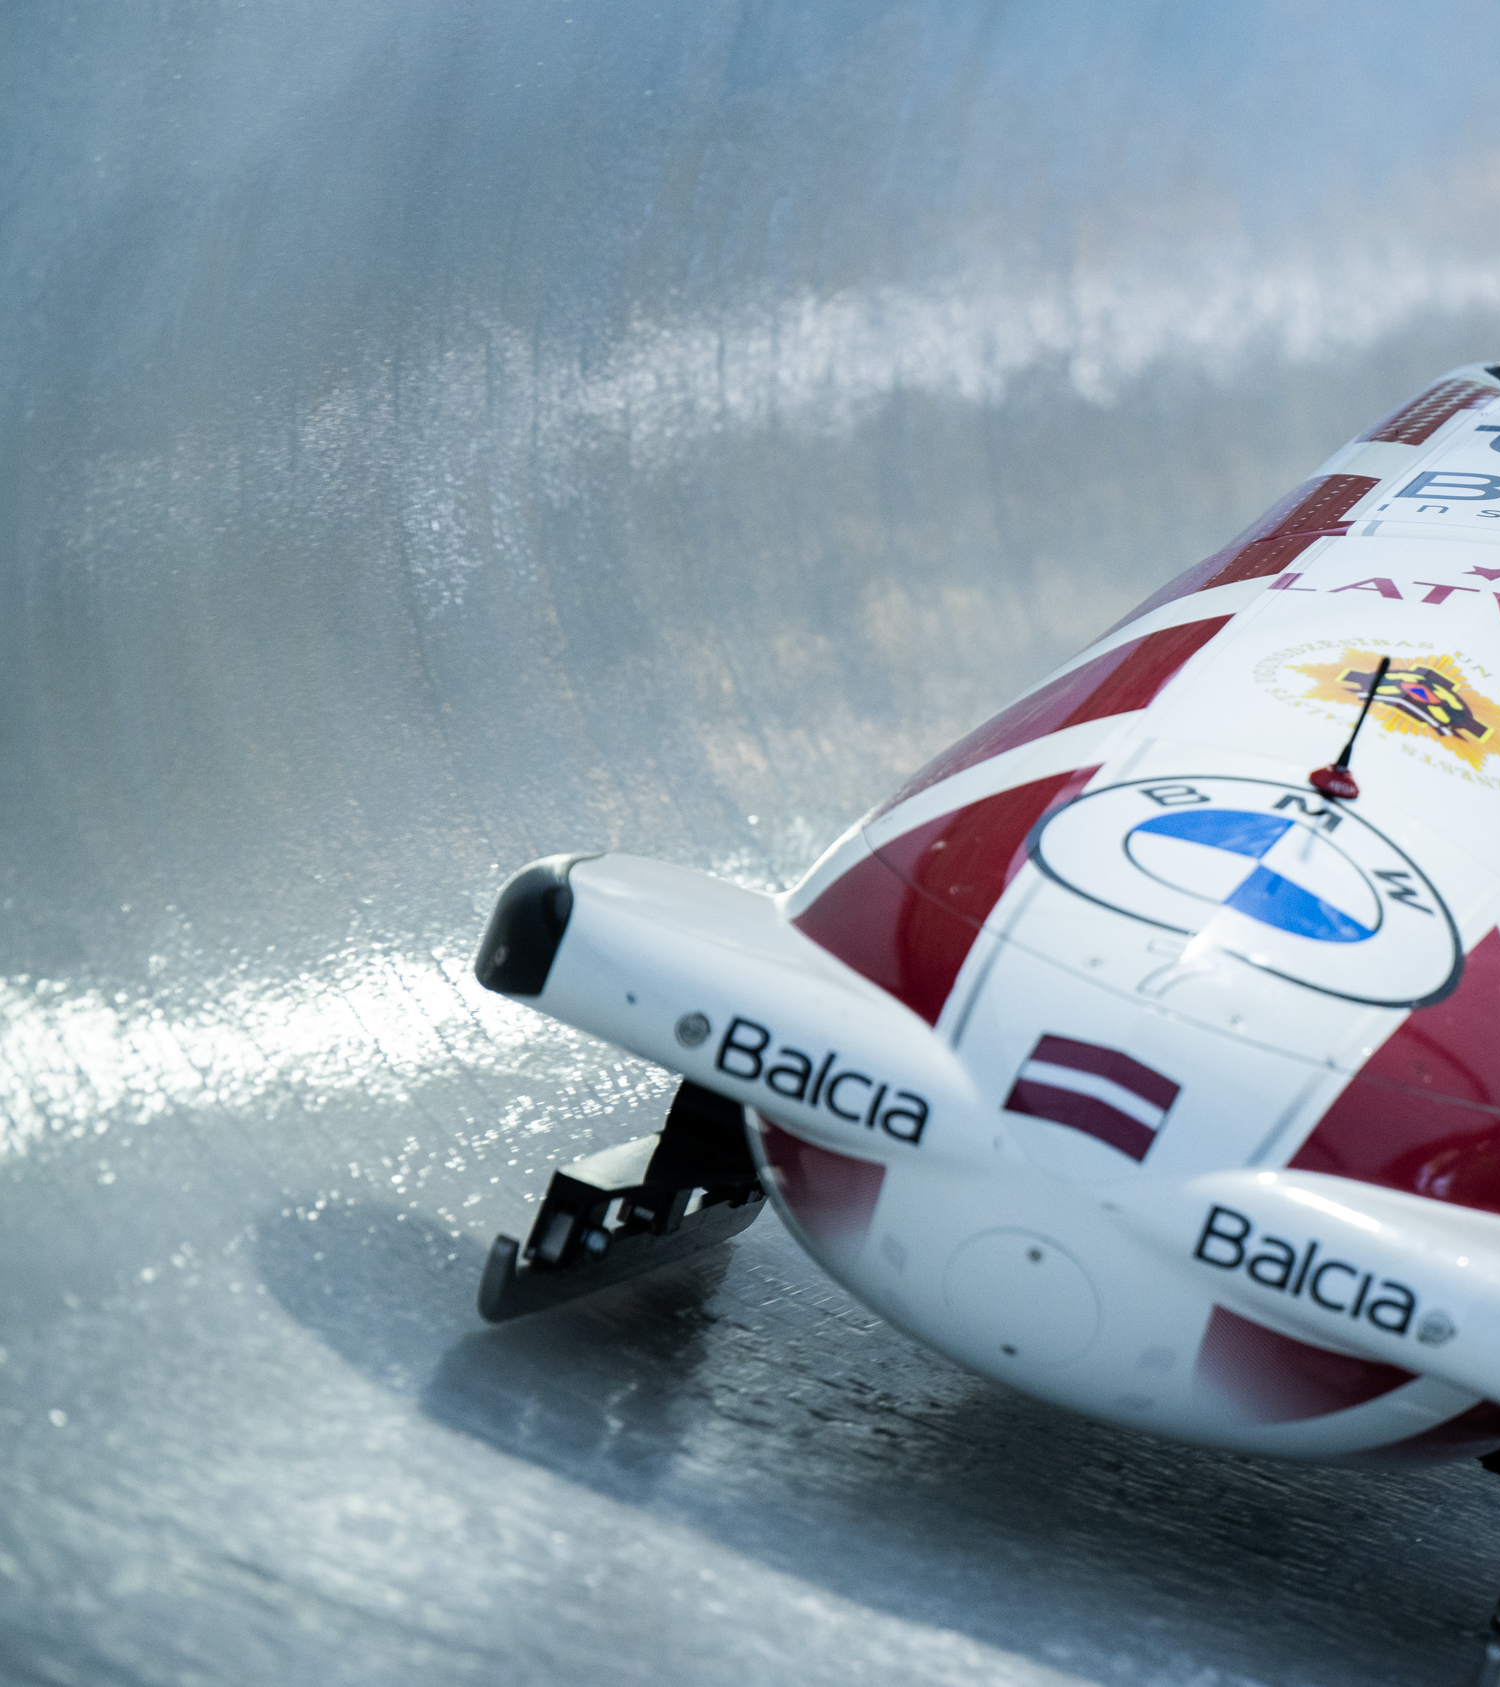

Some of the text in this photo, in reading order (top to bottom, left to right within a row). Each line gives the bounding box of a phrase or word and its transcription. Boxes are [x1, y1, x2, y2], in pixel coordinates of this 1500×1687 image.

[1454, 651, 1493, 678] UN
[1138, 784, 1436, 917] BMW
[713, 1016, 931, 1147] Balcia
[1191, 1205, 1419, 1337] Balcia
